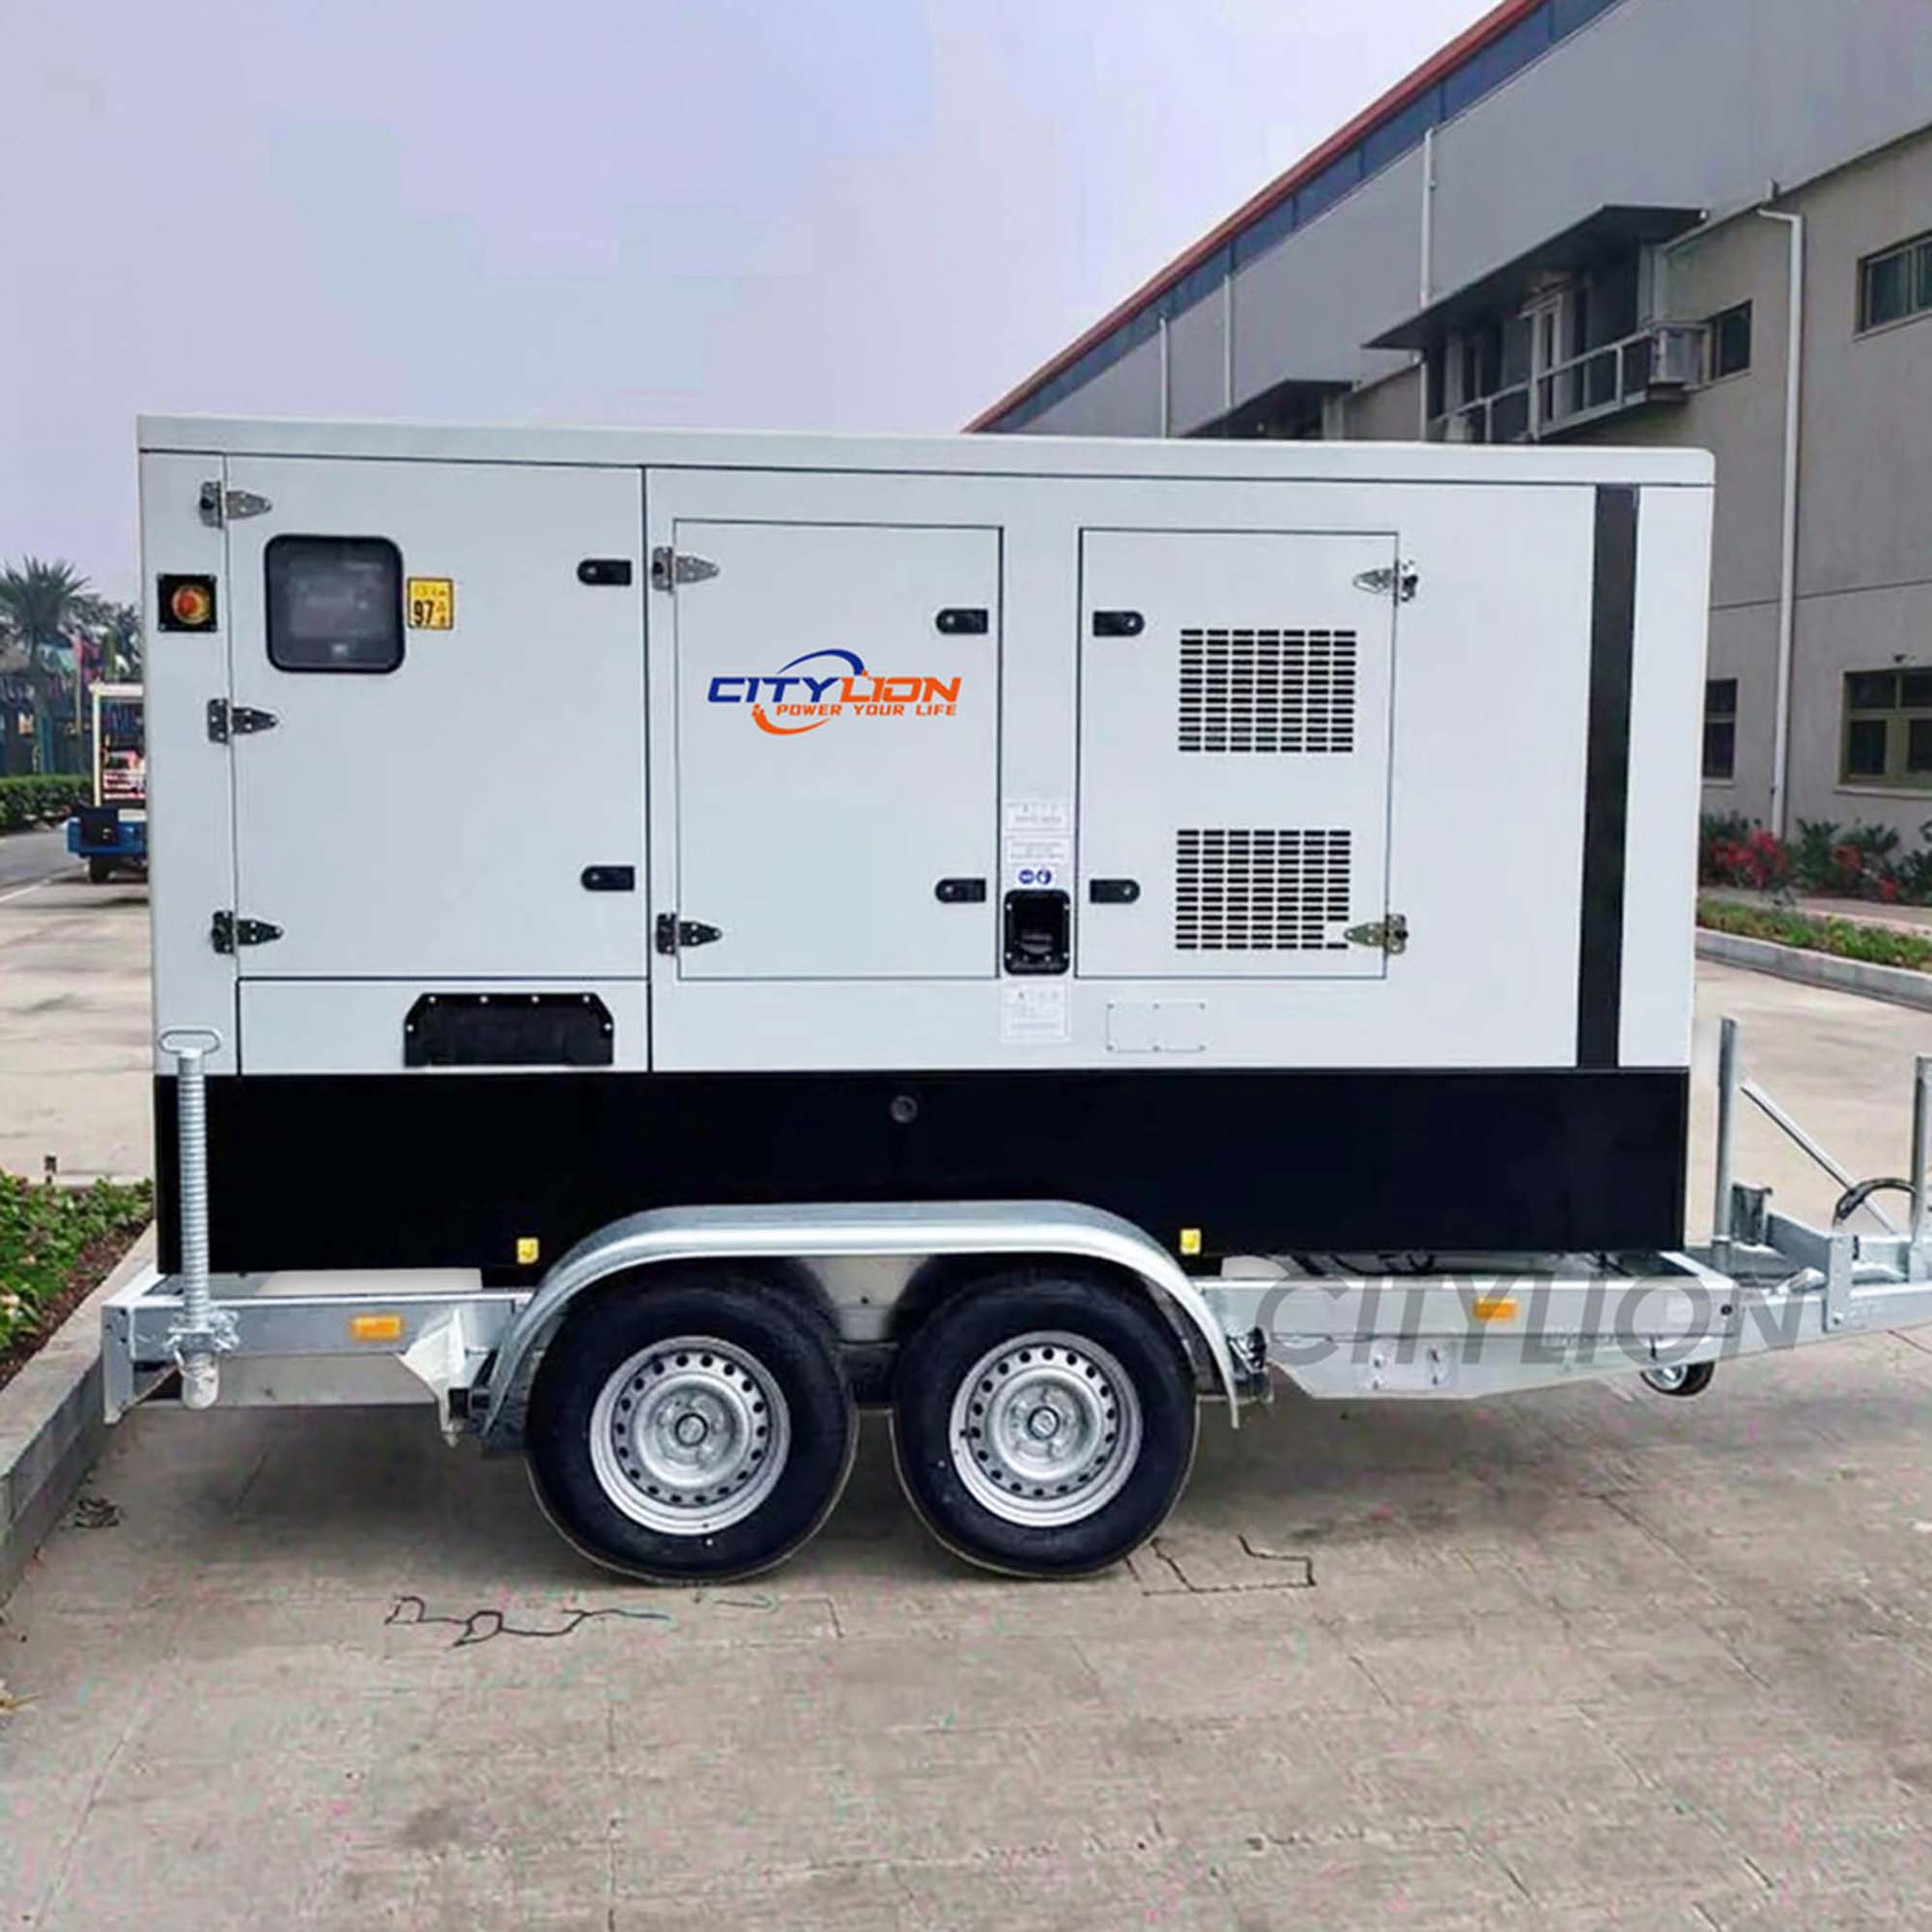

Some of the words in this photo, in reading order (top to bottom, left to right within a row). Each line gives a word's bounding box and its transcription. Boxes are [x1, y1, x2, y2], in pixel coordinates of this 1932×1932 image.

[707, 676, 962, 703] CITYLION
[776, 704, 842, 716] POWER
[853, 704, 905, 716] YOUR
[915, 704, 957, 716] LIFE
